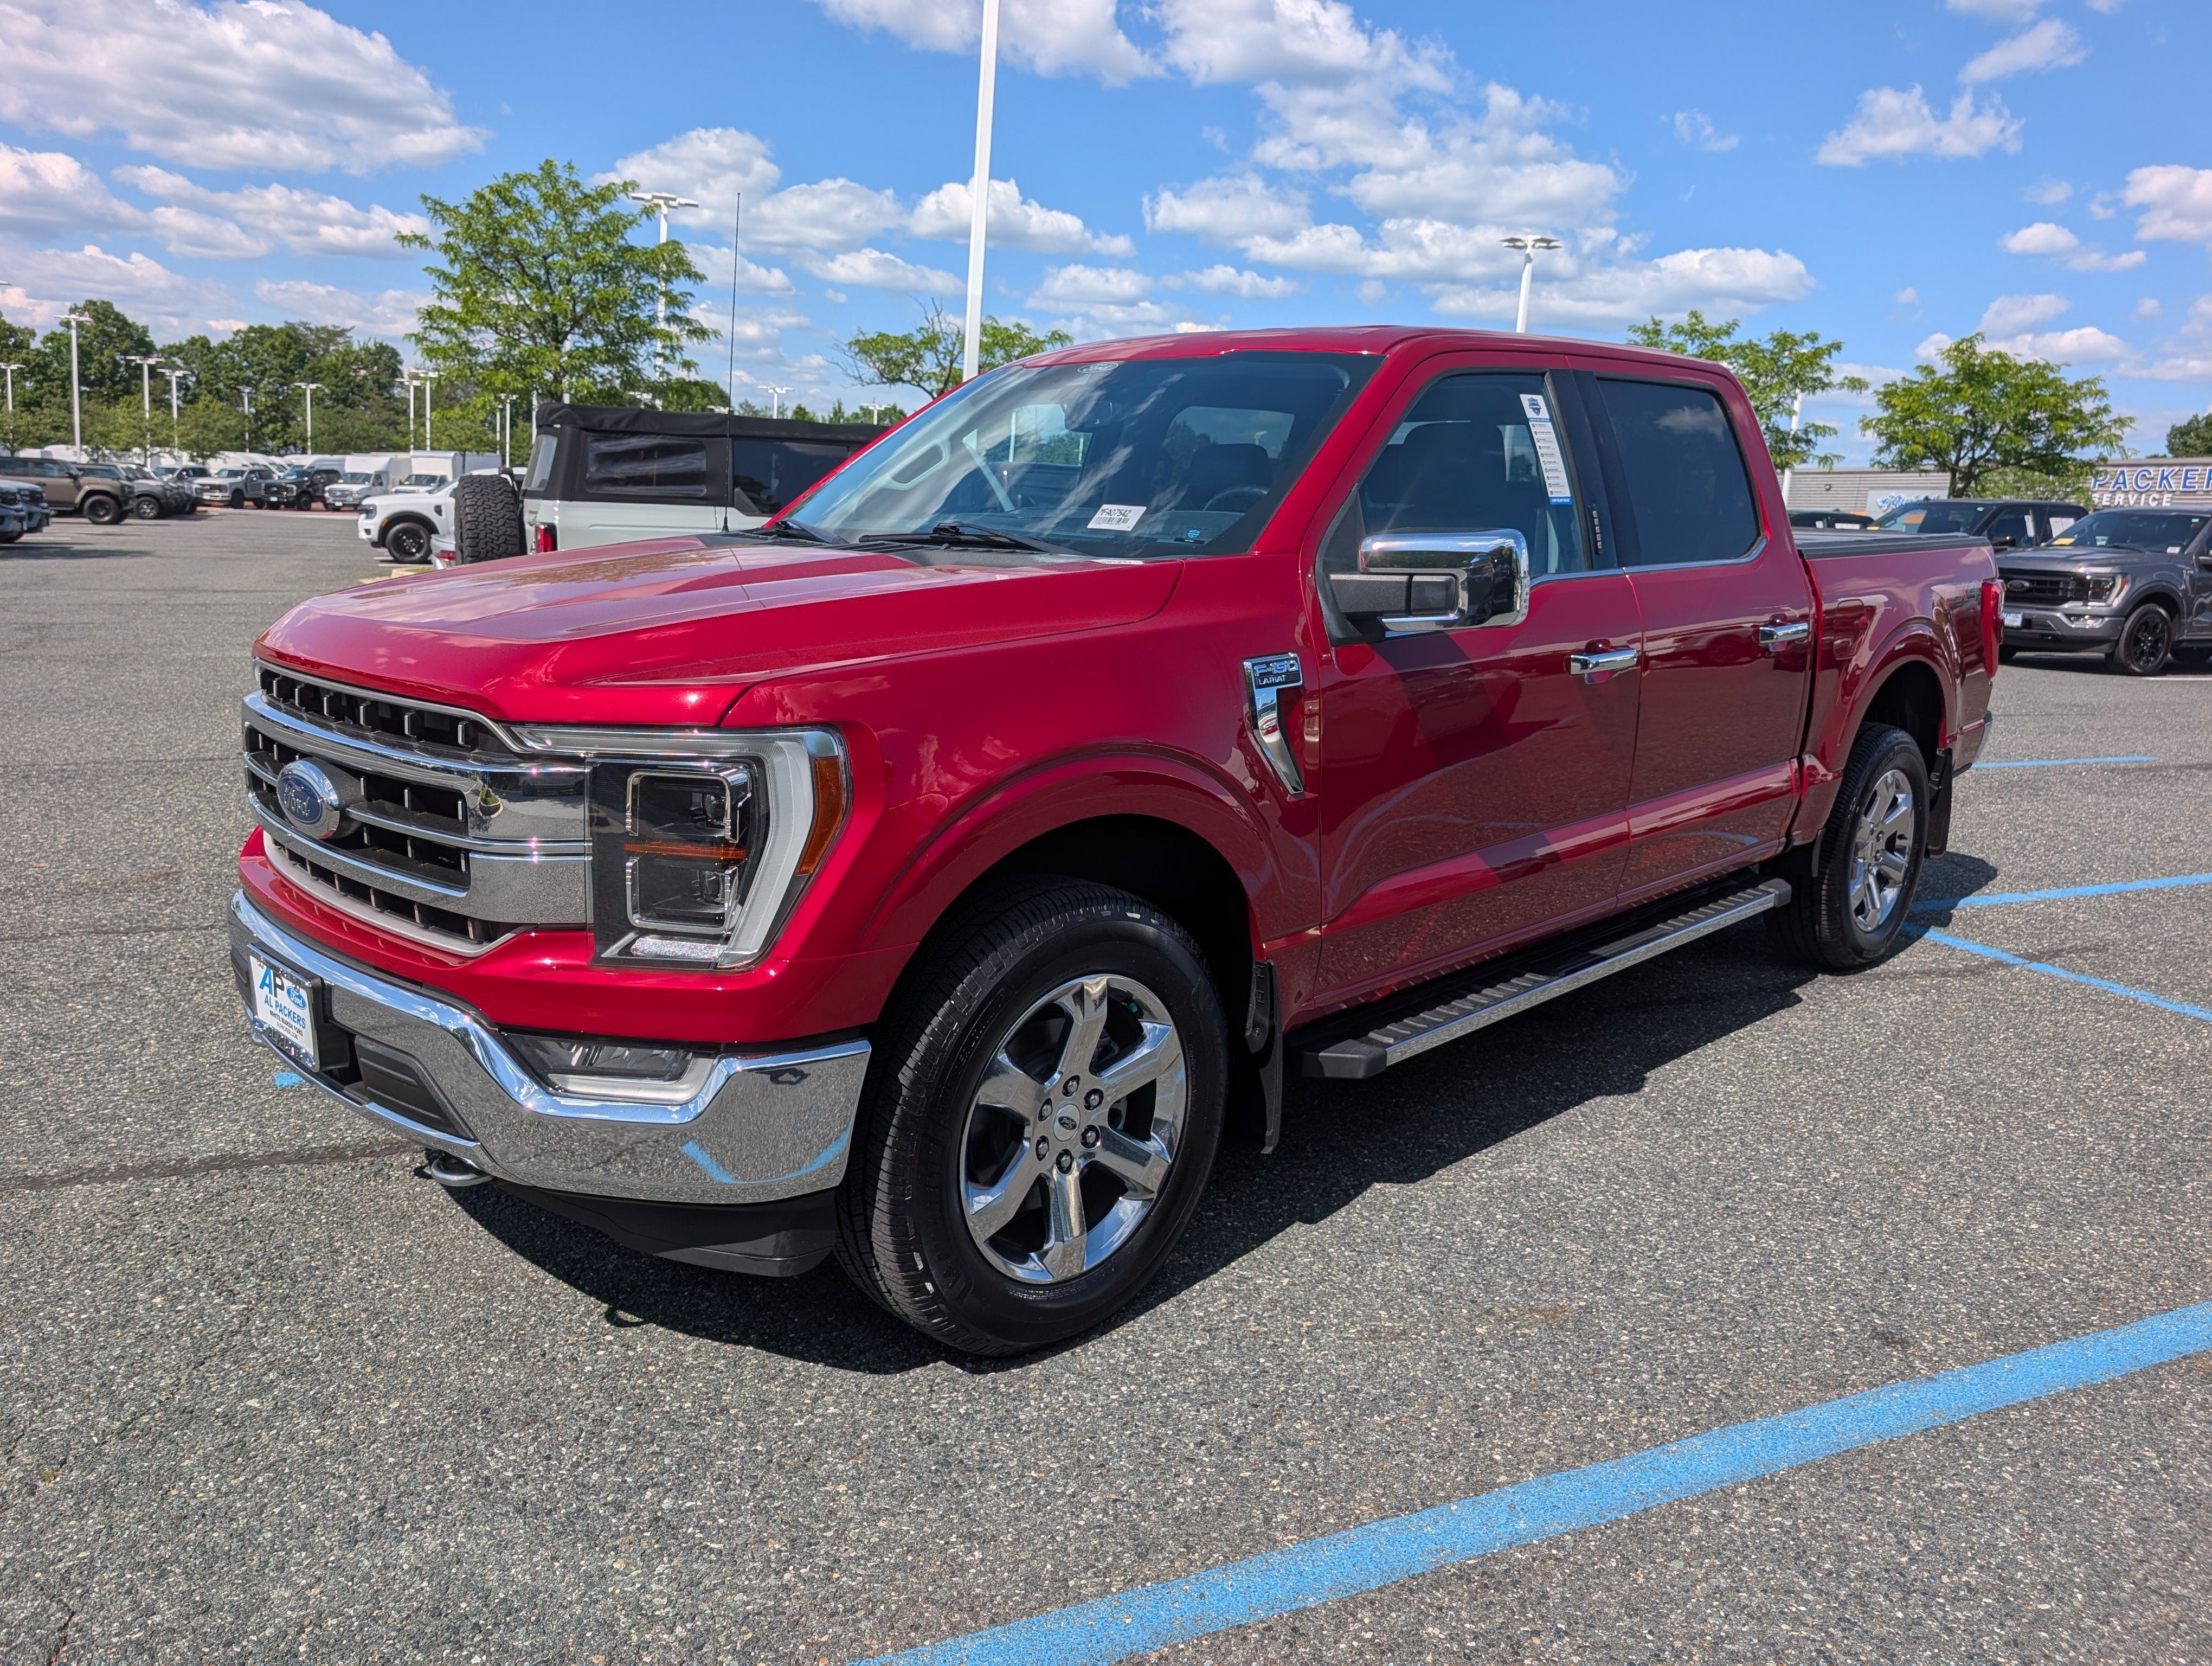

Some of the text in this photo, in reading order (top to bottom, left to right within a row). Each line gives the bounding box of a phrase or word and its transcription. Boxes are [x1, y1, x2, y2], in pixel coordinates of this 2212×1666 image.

[1081, 363, 1115, 372] Ford
[2091, 492, 2173, 507] SERVICE
[1254, 660, 1298, 677] F-150
[1257, 675, 1287, 685] LARIAT
[281, 778, 316, 819] Ford
[259, 967, 285, 998] AP
[288, 987, 305, 1008] Ford
[265, 995, 273, 1008] AL
[275, 1001, 306, 1029] PACKERS
[1060, 1117, 1076, 1129] Ford
